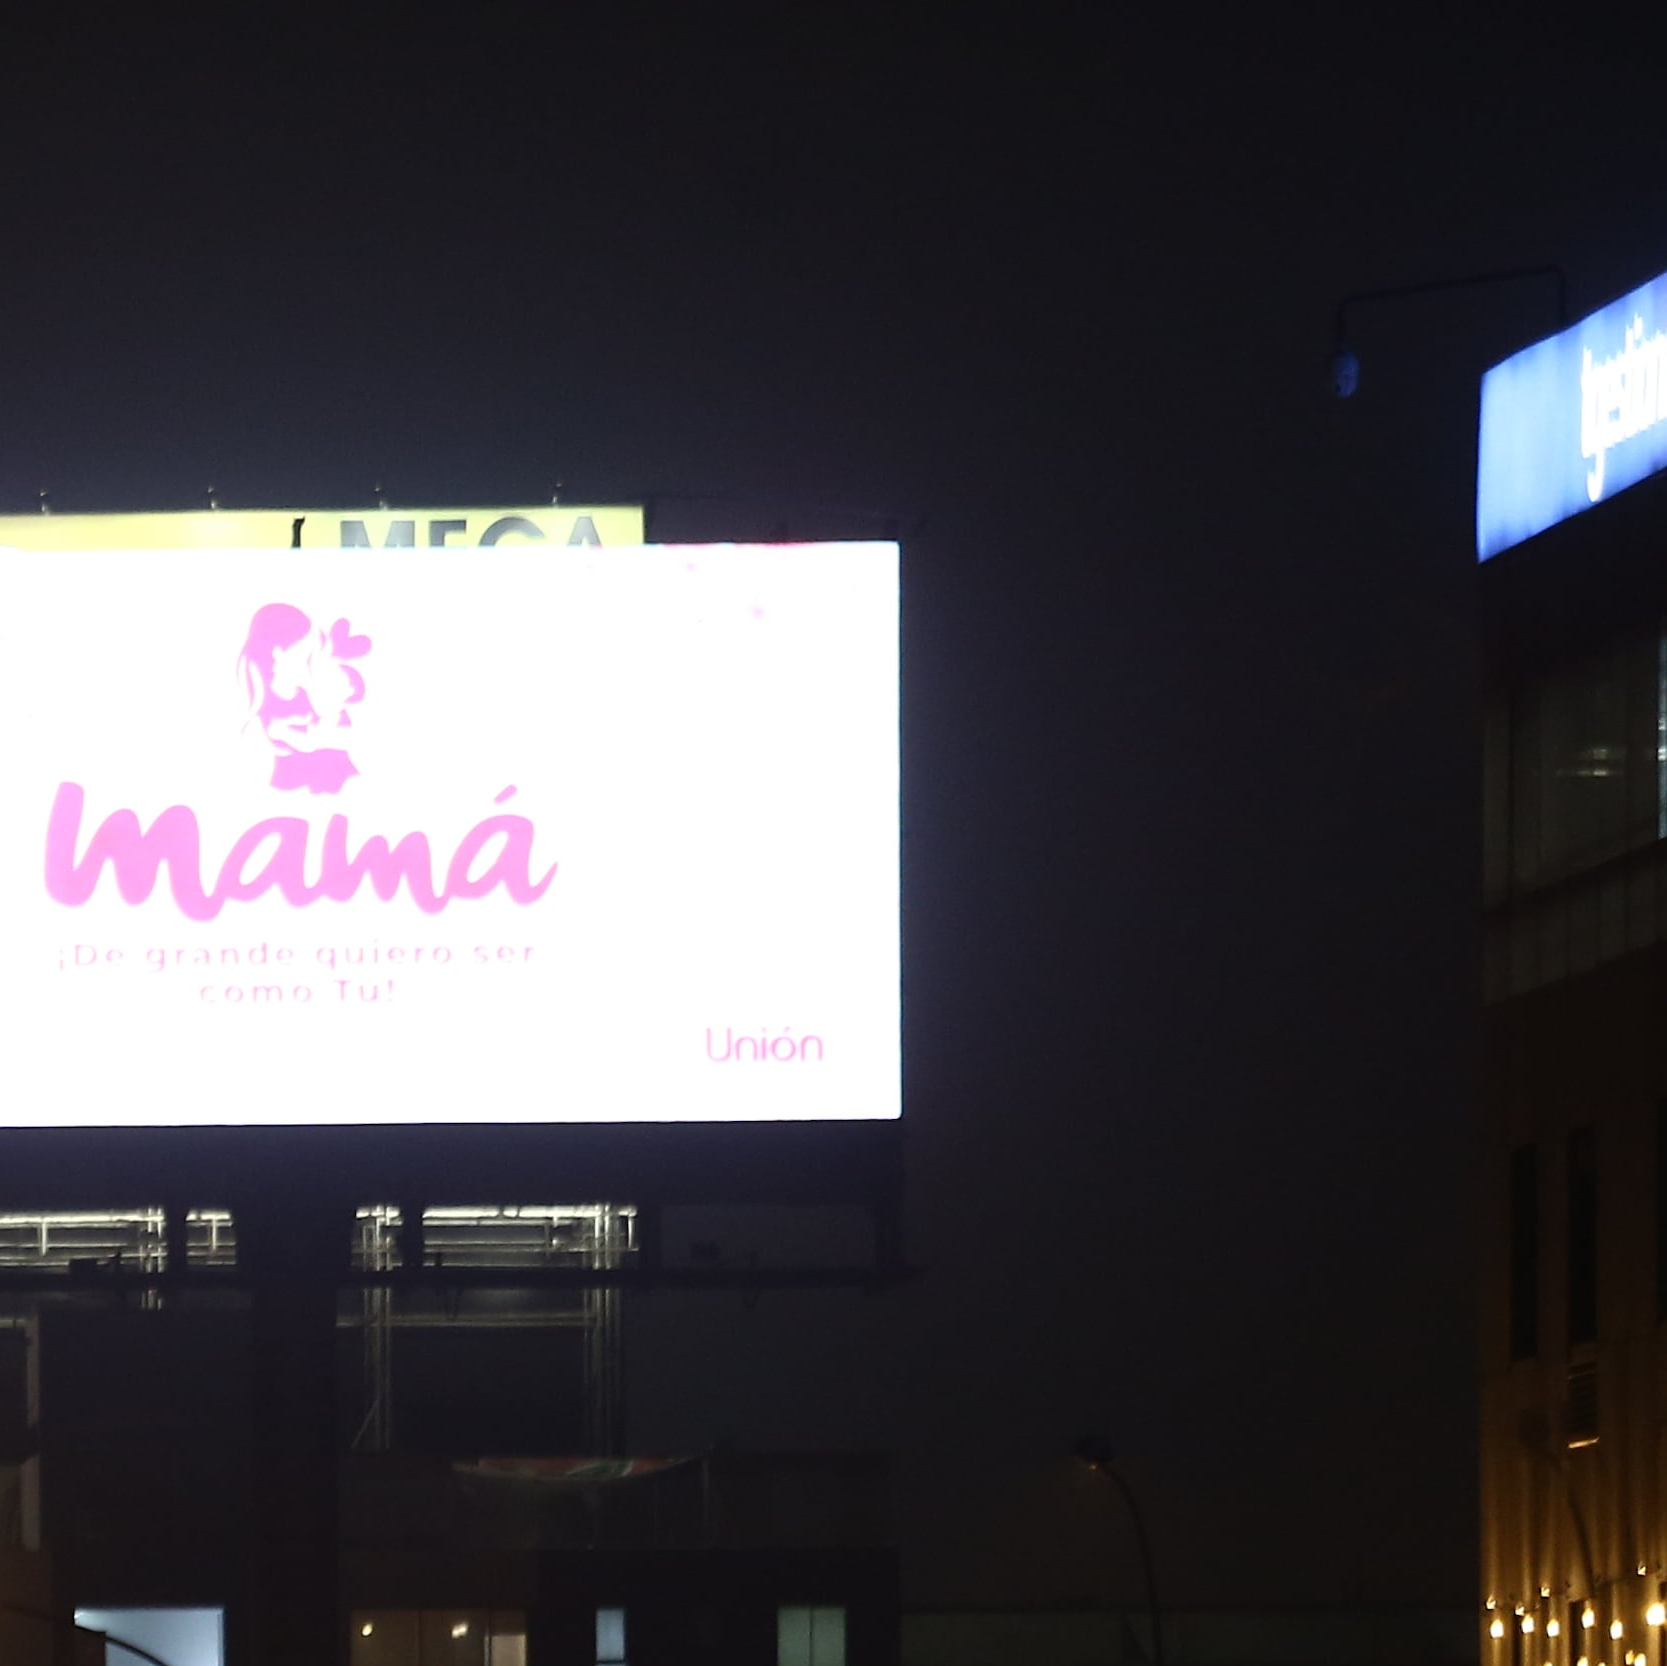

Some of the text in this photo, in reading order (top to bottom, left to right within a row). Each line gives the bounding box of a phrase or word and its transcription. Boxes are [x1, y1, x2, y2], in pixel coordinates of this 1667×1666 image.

[146, 942, 295, 973] grande
[315, 939, 452, 970] quiero
[473, 943, 534, 965] ser
[200, 982, 312, 1004] como
[705, 1026, 823, 1062] Unión
